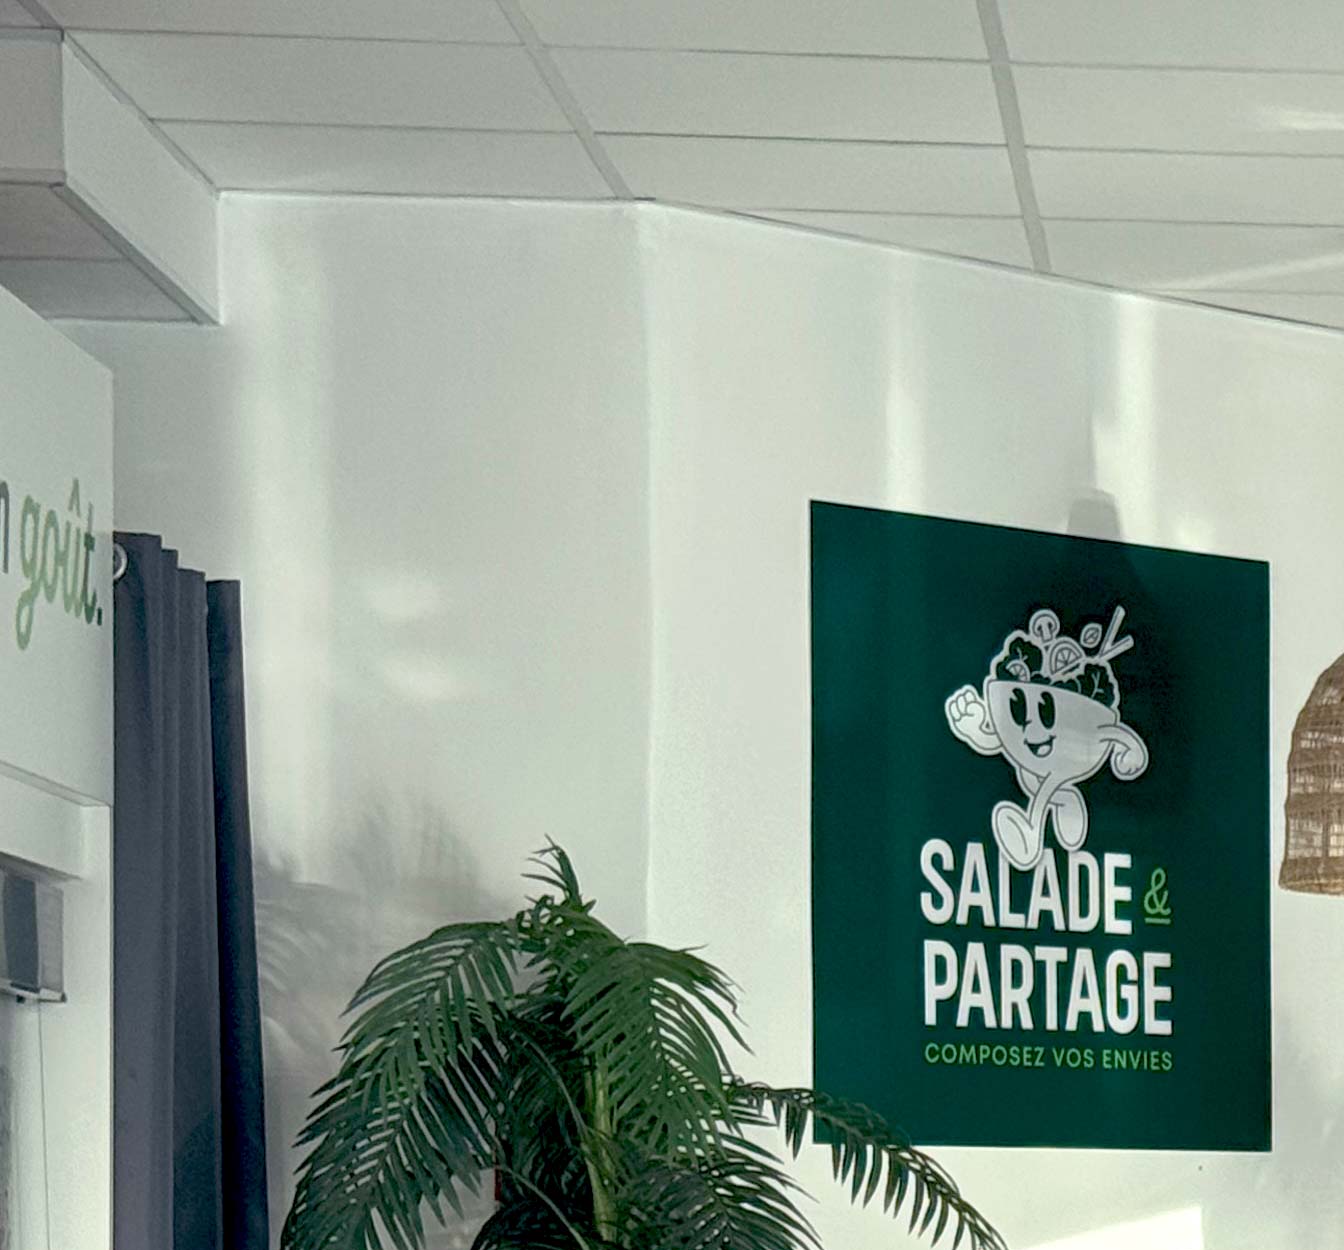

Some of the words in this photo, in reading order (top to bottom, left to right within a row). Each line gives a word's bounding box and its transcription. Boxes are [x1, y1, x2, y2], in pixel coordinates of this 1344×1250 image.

[920, 838, 1132, 935] SALADE
[1143, 867, 1172, 924] &
[924, 939, 1173, 1036] PARTAGE
[925, 1043, 1045, 1068] COMPOSEZ
[1052, 1047, 1095, 1069] VOS
[1103, 1048, 1173, 1071] ENVIES
